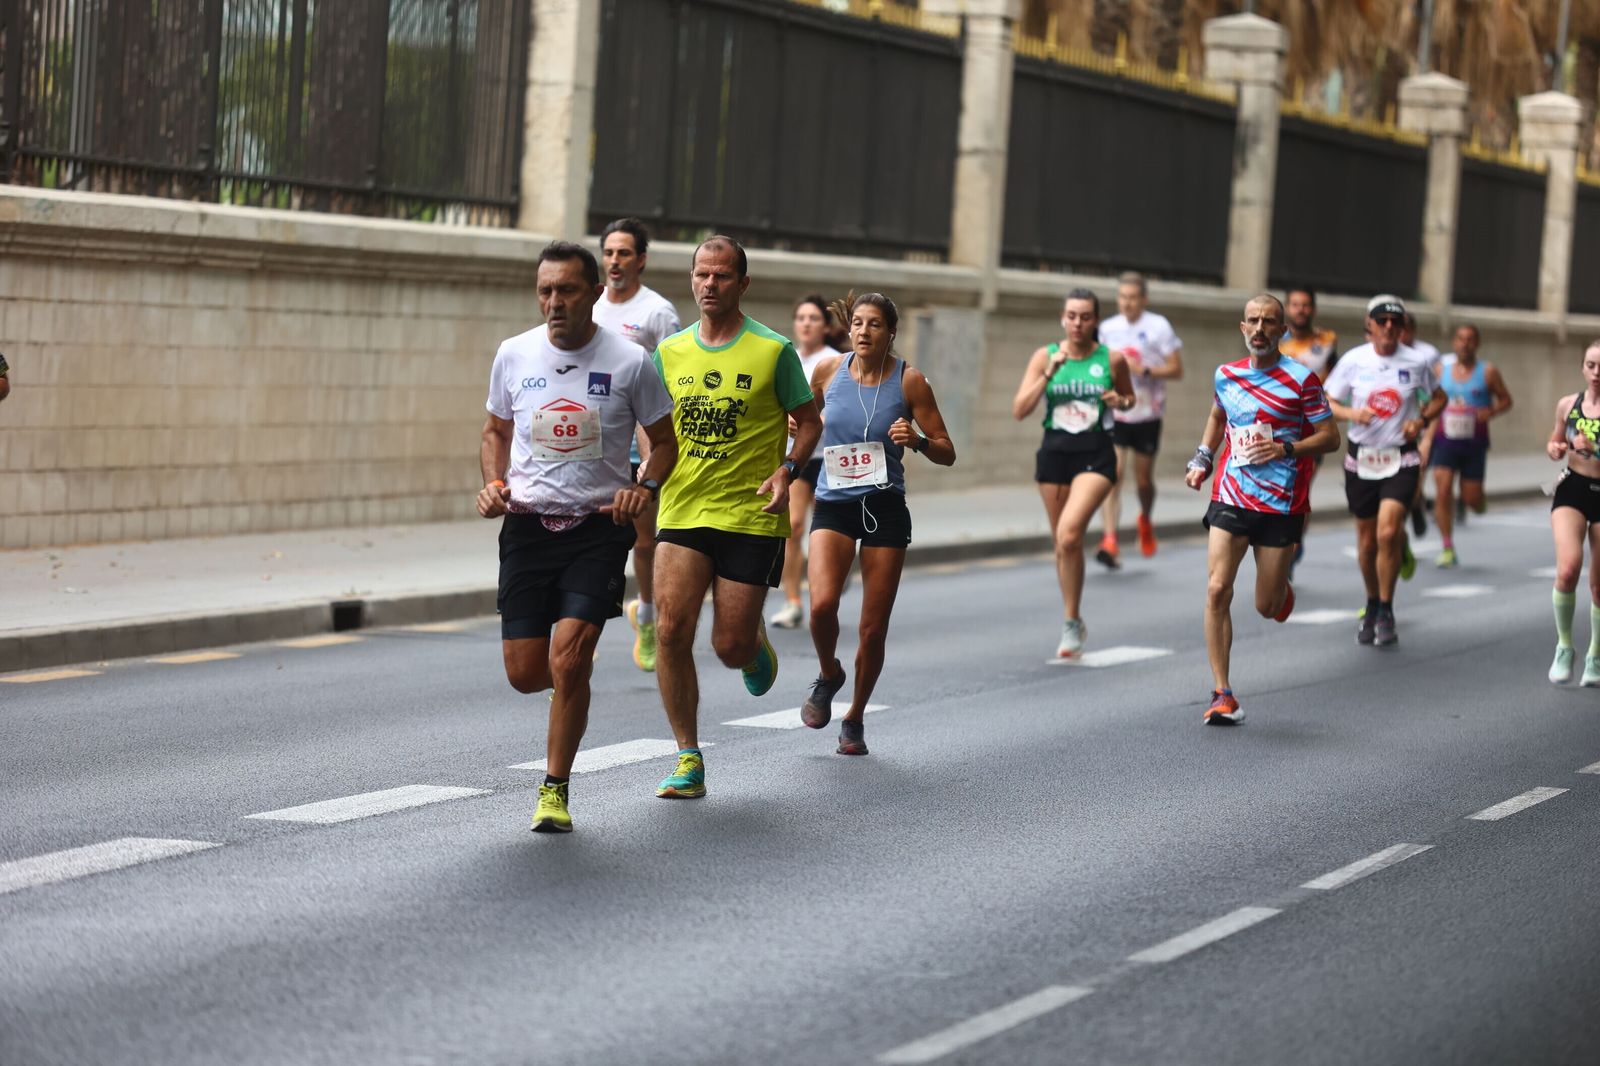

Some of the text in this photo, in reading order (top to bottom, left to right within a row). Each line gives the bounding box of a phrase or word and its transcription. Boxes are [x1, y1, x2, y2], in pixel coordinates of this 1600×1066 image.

[680, 407, 737, 423] PONLE
[553, 424, 578, 437] 68
[681, 421, 738, 438] FRENO
[687, 447, 728, 460] MÁLAGA
[839, 453, 872, 468] 318
